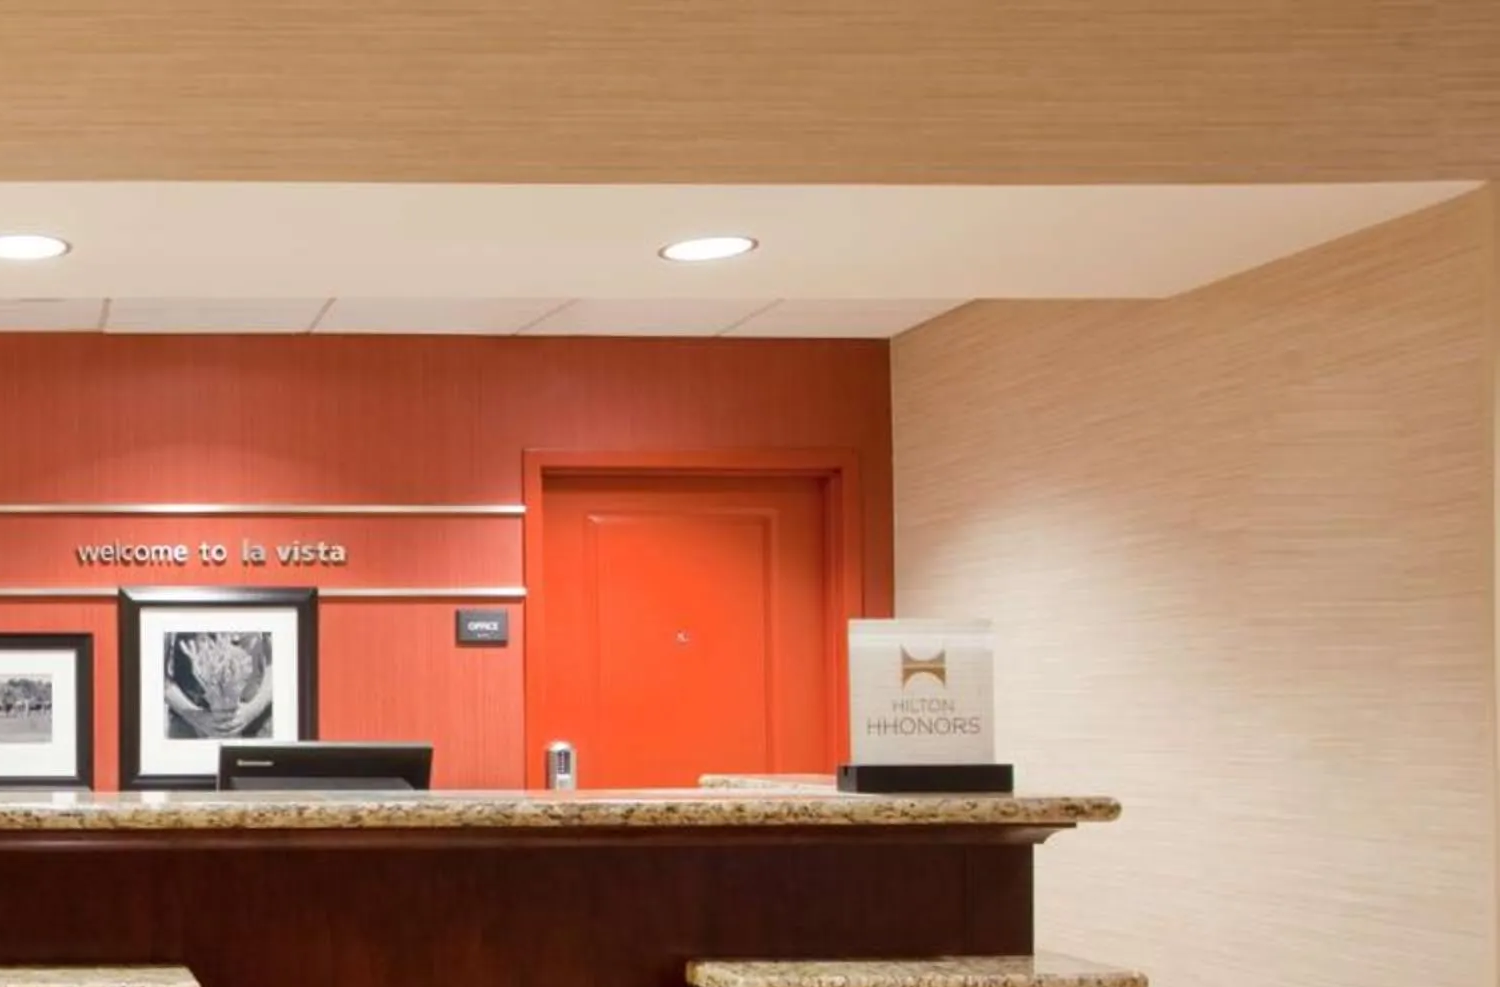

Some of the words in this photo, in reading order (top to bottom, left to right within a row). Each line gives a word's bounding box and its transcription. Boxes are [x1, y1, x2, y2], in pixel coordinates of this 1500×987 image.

[76, 539, 189, 563] welcome
[198, 541, 228, 563] to
[241, 539, 267, 563] la
[275, 539, 347, 563] vista
[891, 698, 956, 714] HILTON
[866, 716, 982, 736] HHONORS
